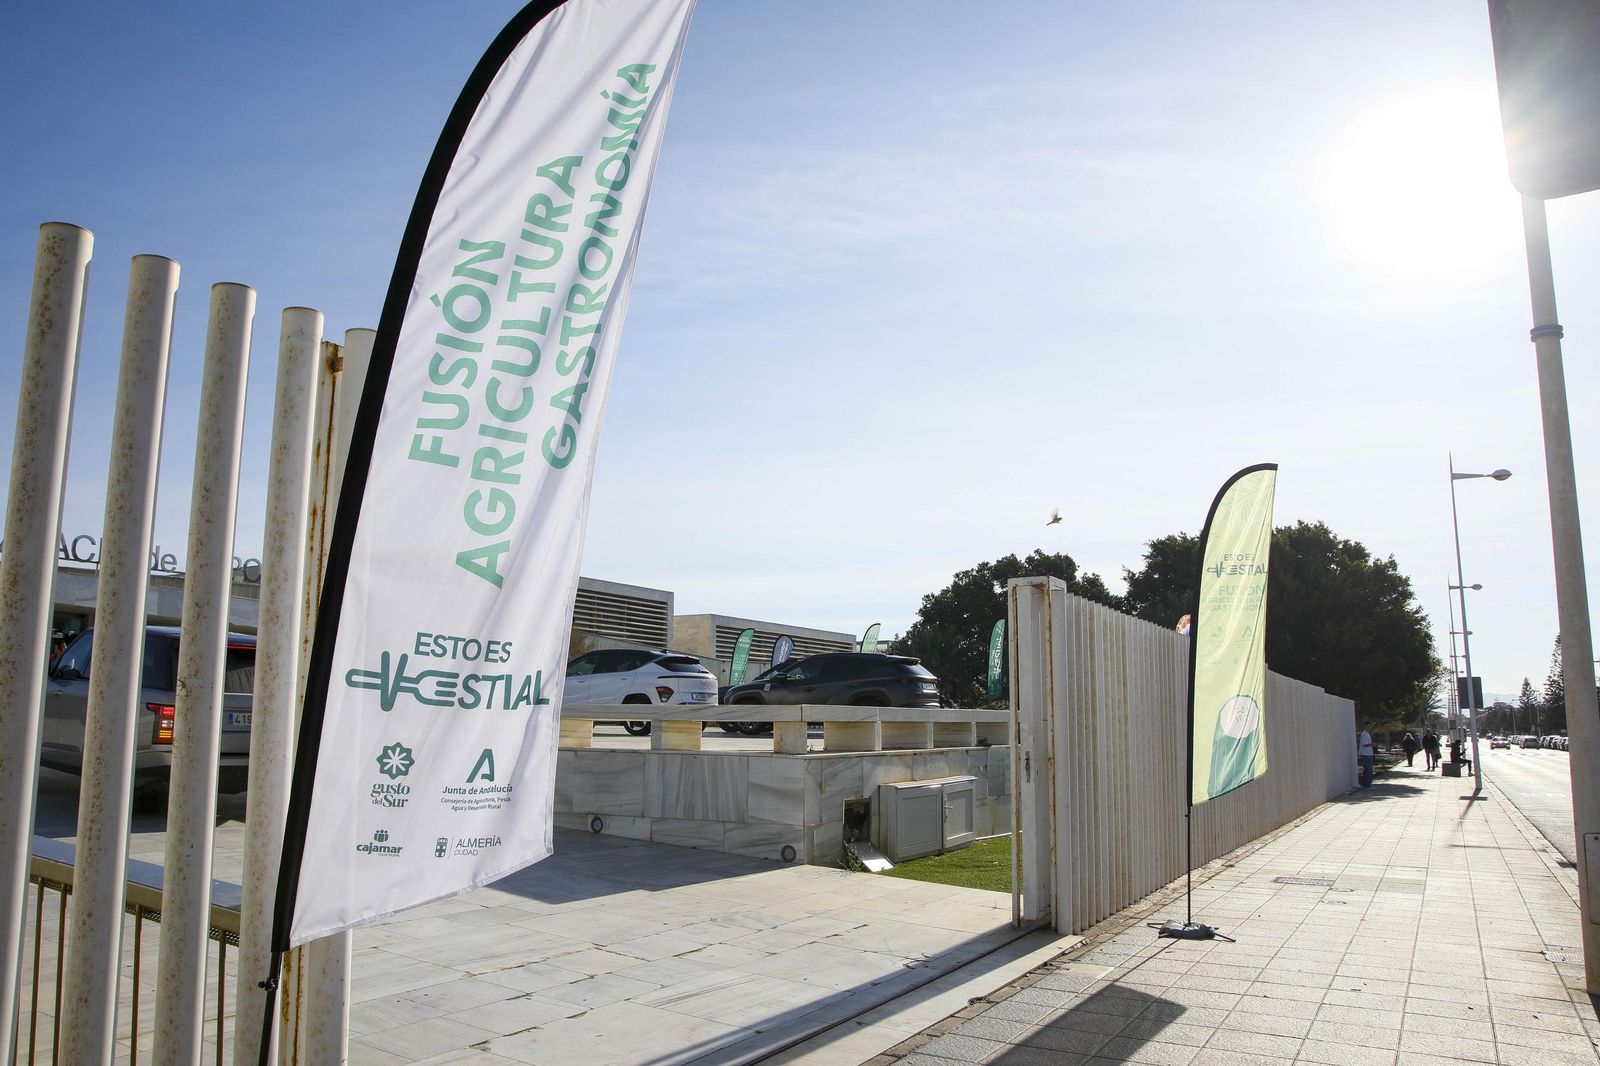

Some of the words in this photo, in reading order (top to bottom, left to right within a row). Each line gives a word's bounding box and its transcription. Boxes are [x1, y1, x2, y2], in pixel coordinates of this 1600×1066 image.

[542, 63, 657, 469] GASTRONOMÍA
[408, 239, 505, 468] FUSIÓN
[456, 155, 583, 589] AGRICULTURA
[370, 782, 410, 798] gusto
[443, 786, 466, 795] Junta
[468, 786, 478, 795] de
[479, 784, 513, 794] Andalucía
[383, 793, 409, 808] Sur
[356, 842, 403, 855] cajamar
[455, 834, 502, 849] ALMERÍA
